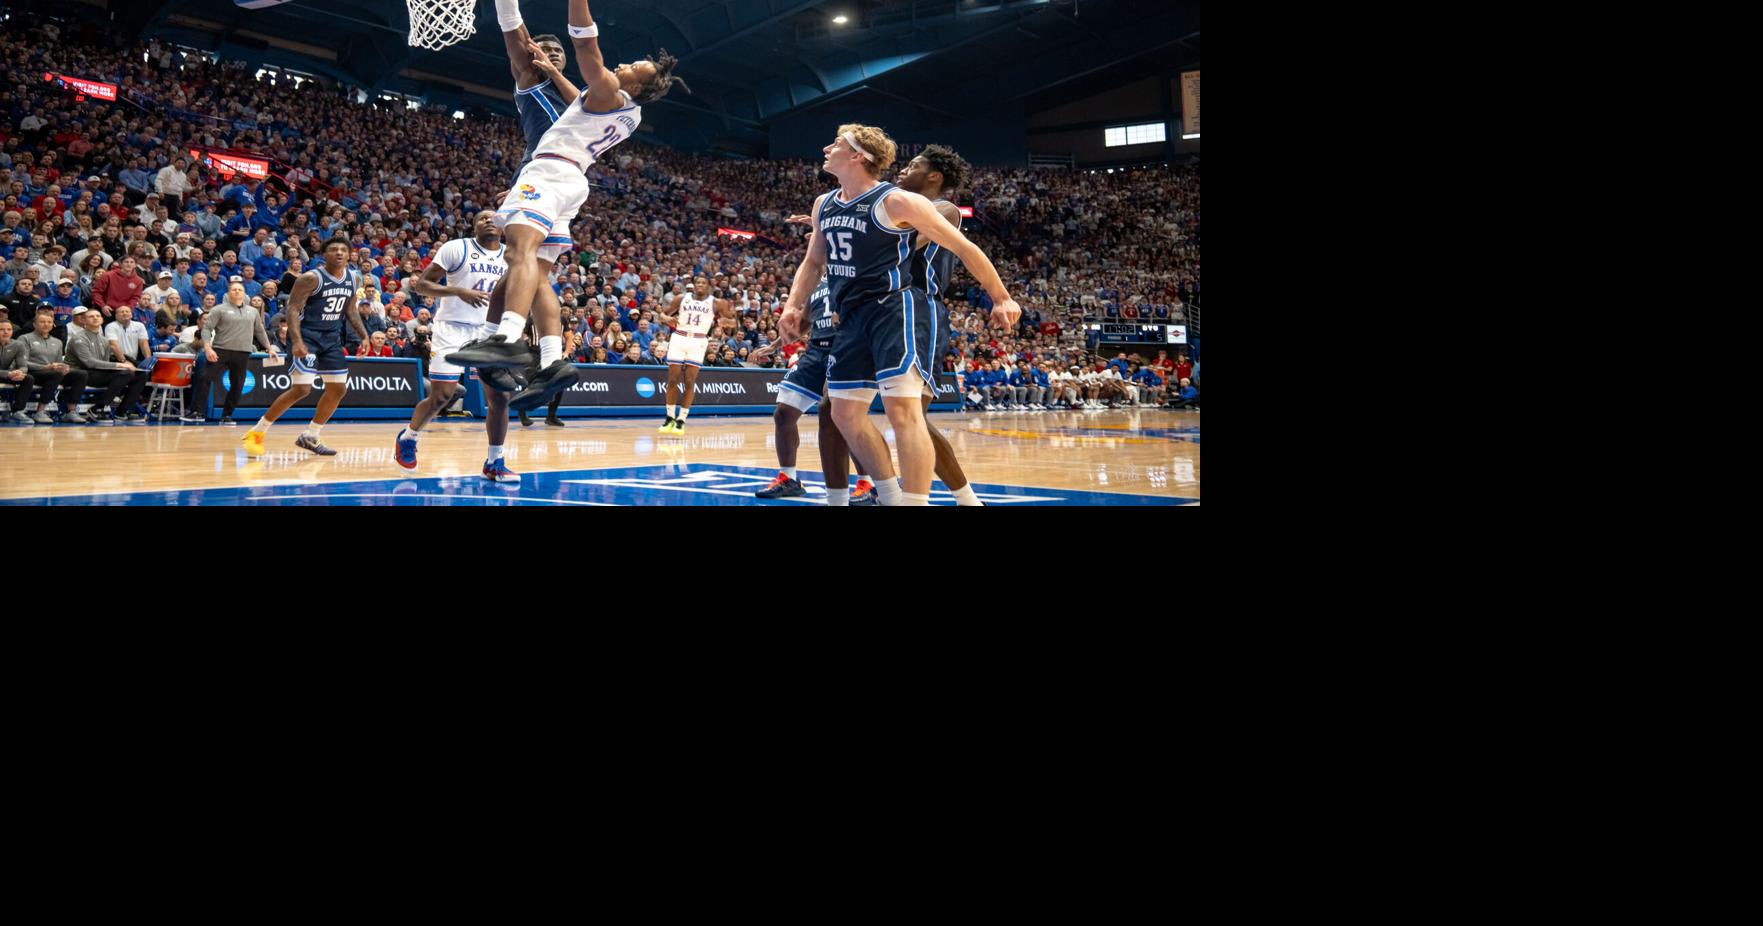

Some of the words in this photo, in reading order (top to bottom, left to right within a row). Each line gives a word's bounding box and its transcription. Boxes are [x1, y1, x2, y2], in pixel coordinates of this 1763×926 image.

[820, 215, 867, 233] BRIGHAM
[826, 232, 852, 261] 15
[470, 263, 507, 276] KANSA
[810, 288, 830, 303] BRIG
[323, 297, 346, 312] 30
[683, 305, 709, 313] KANSAS
[687, 313, 701, 326] 14
[816, 318, 831, 328] YOU
[262, 374, 325, 389] KOC
[658, 382, 701, 394] KNA
[702, 382, 746, 394] MINOLTA
